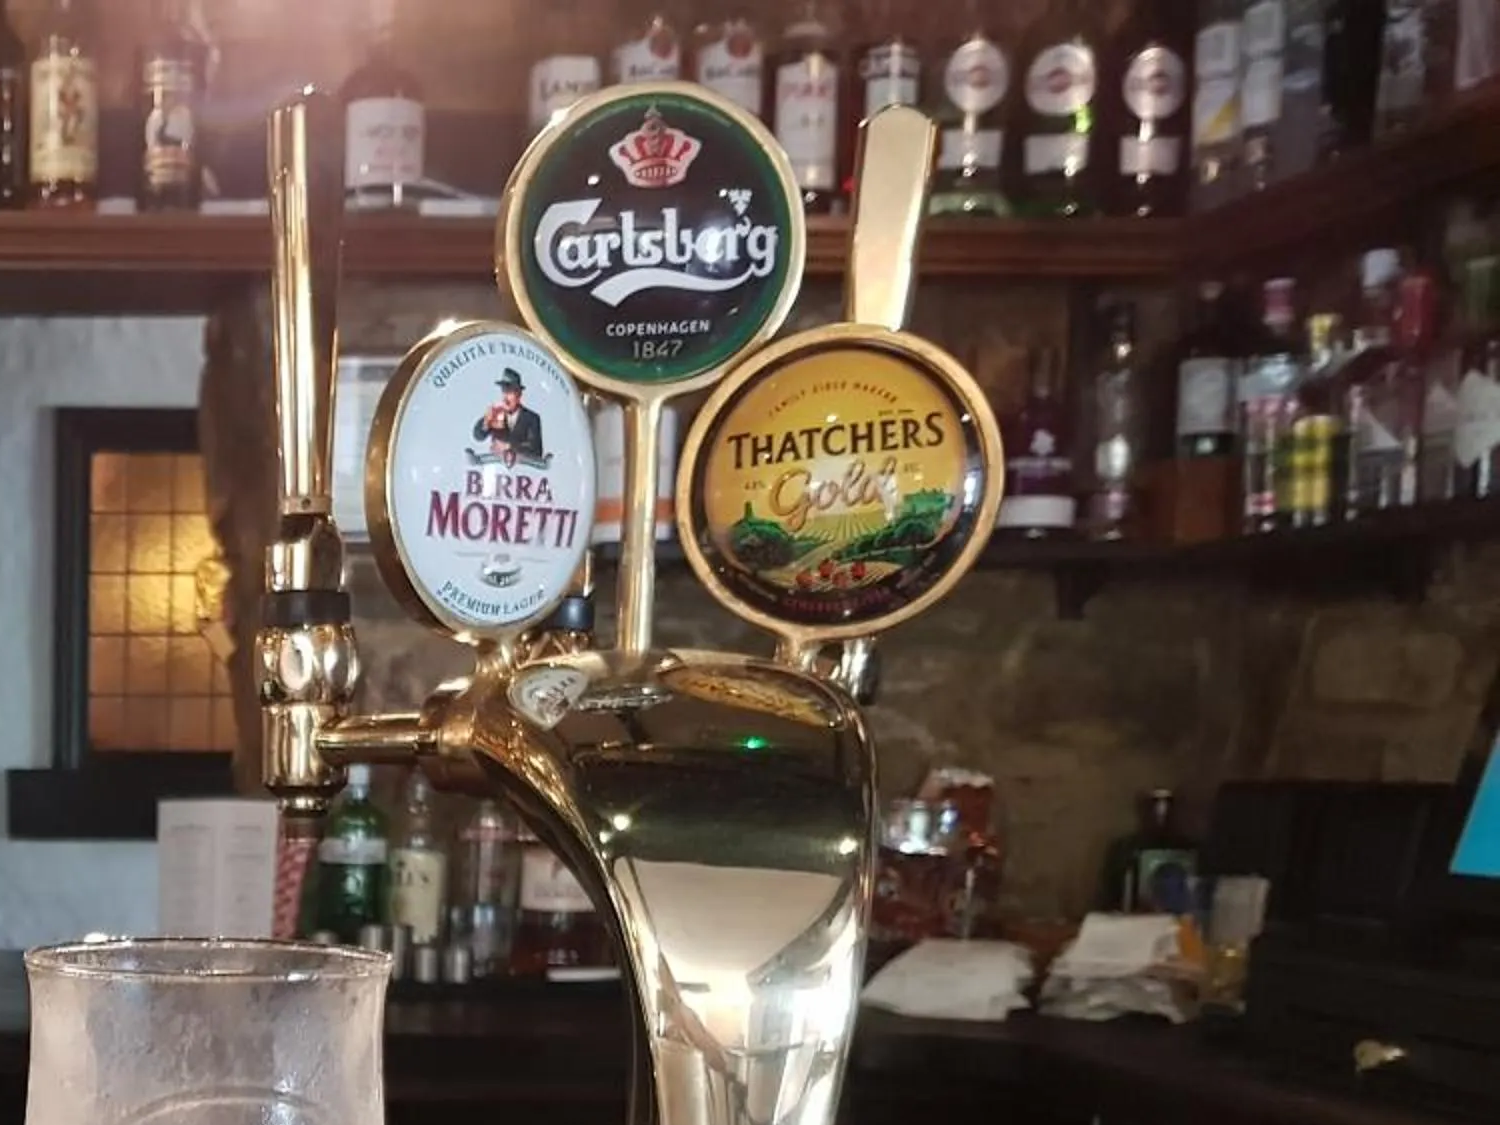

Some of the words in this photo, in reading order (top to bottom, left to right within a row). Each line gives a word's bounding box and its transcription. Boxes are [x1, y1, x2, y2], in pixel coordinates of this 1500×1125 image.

[534, 198, 779, 290] Carlsberg
[606, 319, 710, 337] COPENHAGEN
[632, 340, 683, 359] 1847
[727, 411, 945, 470] THATCHERS
[466, 470, 553, 502] BRRA
[769, 456, 898, 533] Gold
[427, 490, 580, 549] MORETTI
